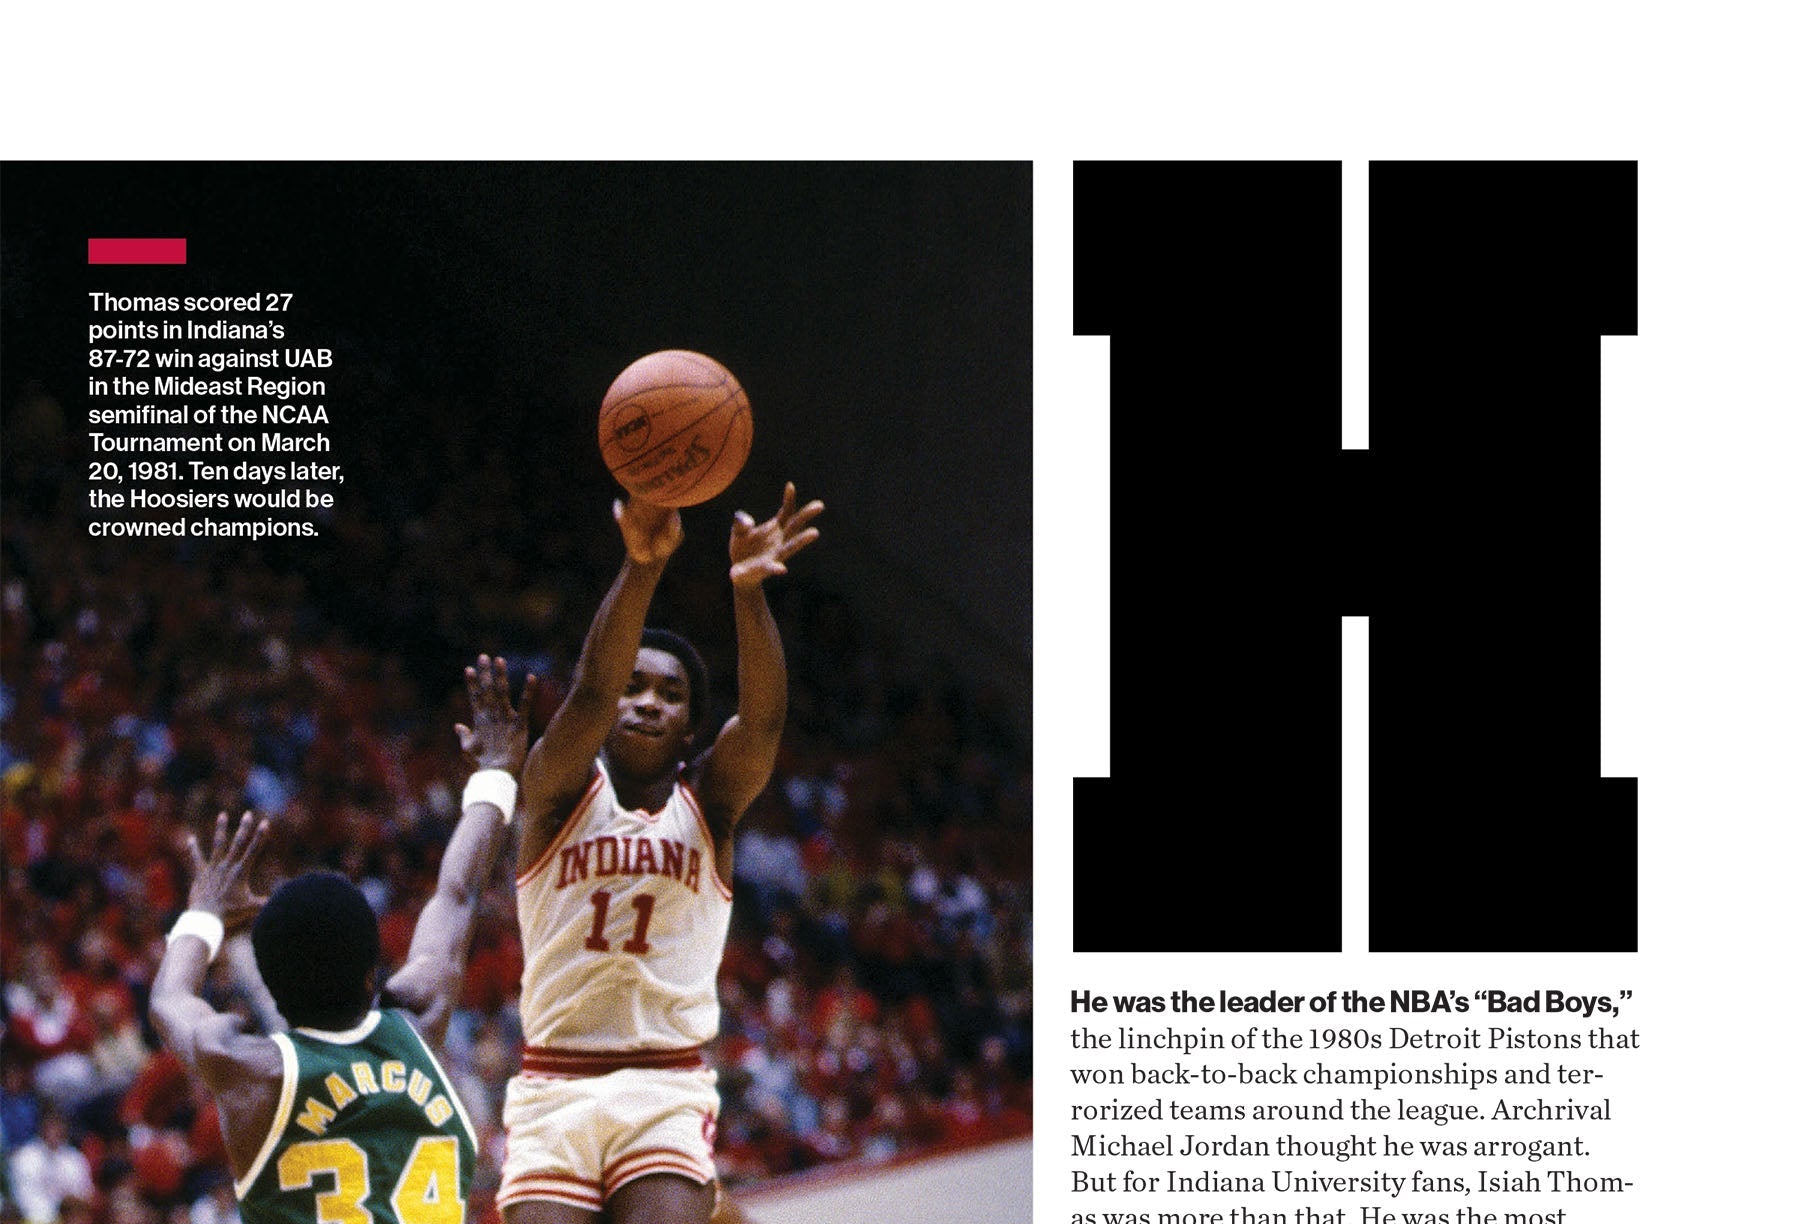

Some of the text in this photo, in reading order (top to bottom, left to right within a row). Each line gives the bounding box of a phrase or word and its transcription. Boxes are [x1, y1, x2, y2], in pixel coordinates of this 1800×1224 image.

[555, 836, 701, 894] INDIANA
[585, 890, 656, 955] 11
[1070, 989, 1633, 1019] He was the leader of the NBA’s “Bad Boys,”
[1070, 1026, 1641, 1055] the linchpin of the 1980s Detroit Pistons that
[1069, 1062, 1604, 1091] won back-to-back championships and ter-
[296, 1060, 454, 1136] MARCUS
[1071, 1169, 1634, 1199] But for Indiana University fans, Isiah Thom-
